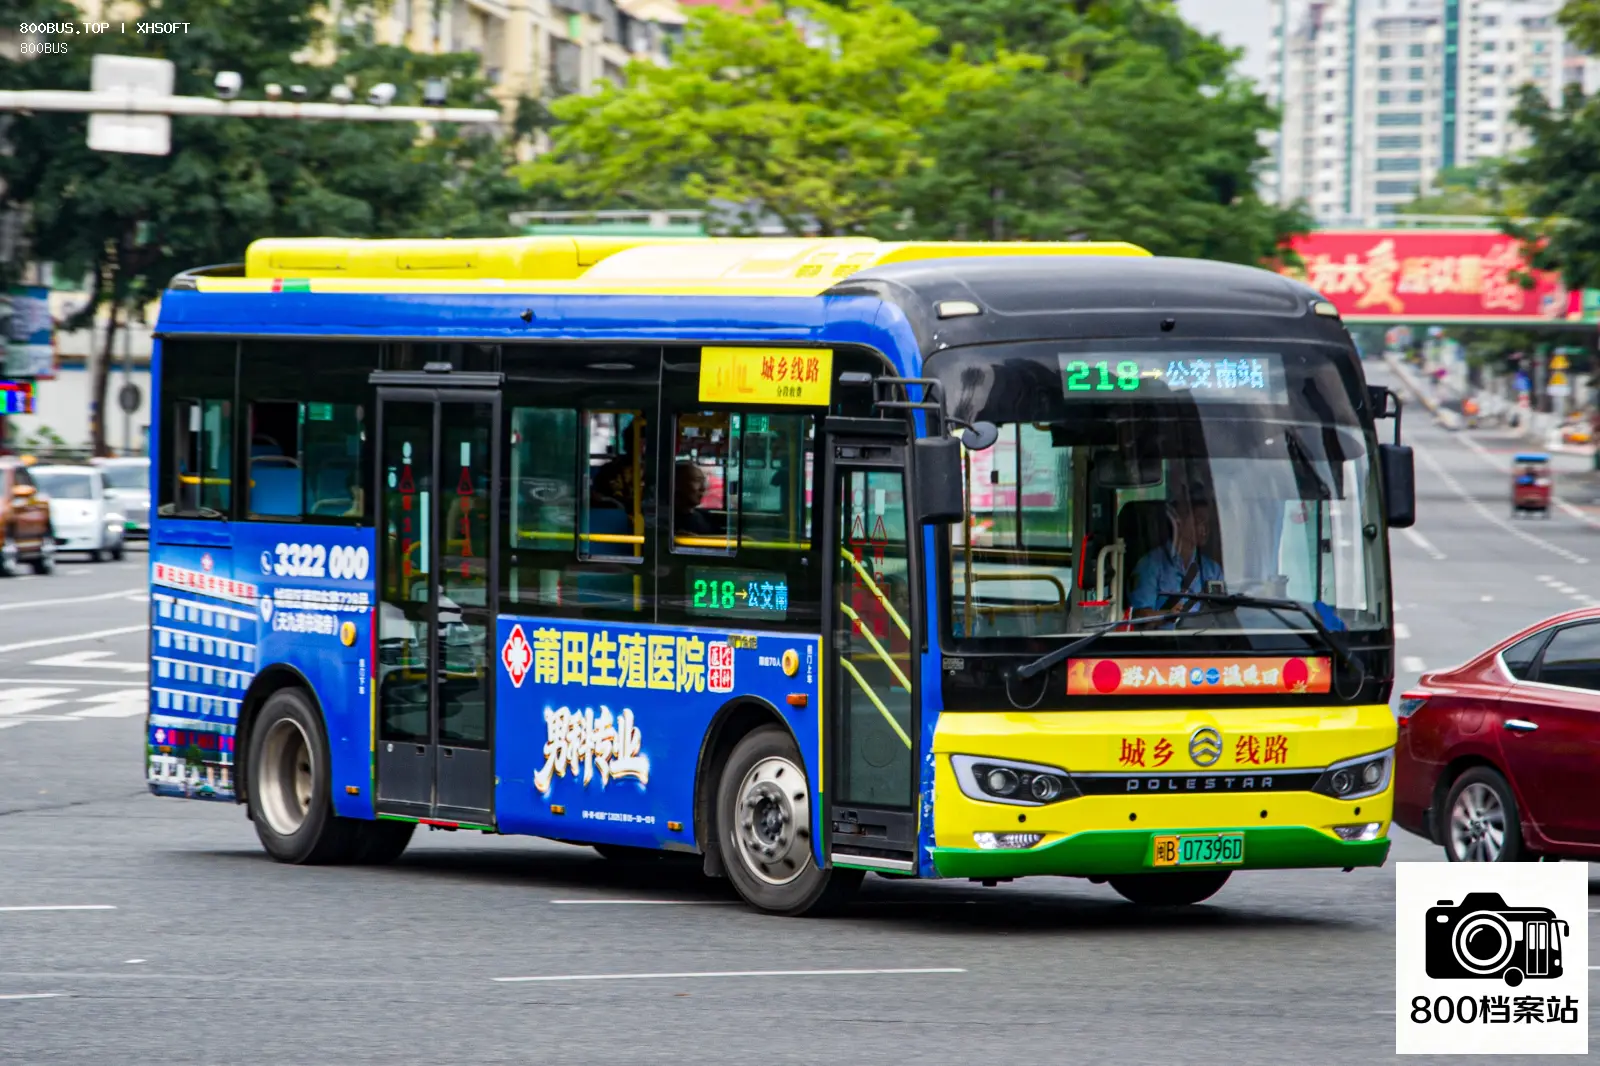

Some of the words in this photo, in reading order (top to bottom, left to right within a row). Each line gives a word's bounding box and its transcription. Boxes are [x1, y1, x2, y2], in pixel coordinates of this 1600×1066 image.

[761, 355, 819, 383] 城乡线路
[1066, 359, 1140, 391] 218
[1166, 358, 1265, 389] 公交南站
[274, 543, 326, 578] 3322
[328, 545, 370, 580] 000
[693, 579, 735, 609] 218
[748, 581, 788, 611] 公交南
[532, 627, 705, 693] 莆田生殖医院
[533, 705, 650, 793] 男科专业
[1118, 737, 1175, 768] 城乡
[1235, 735, 1288, 765] 线路
[1126, 777, 1273, 791] POLESTAR
